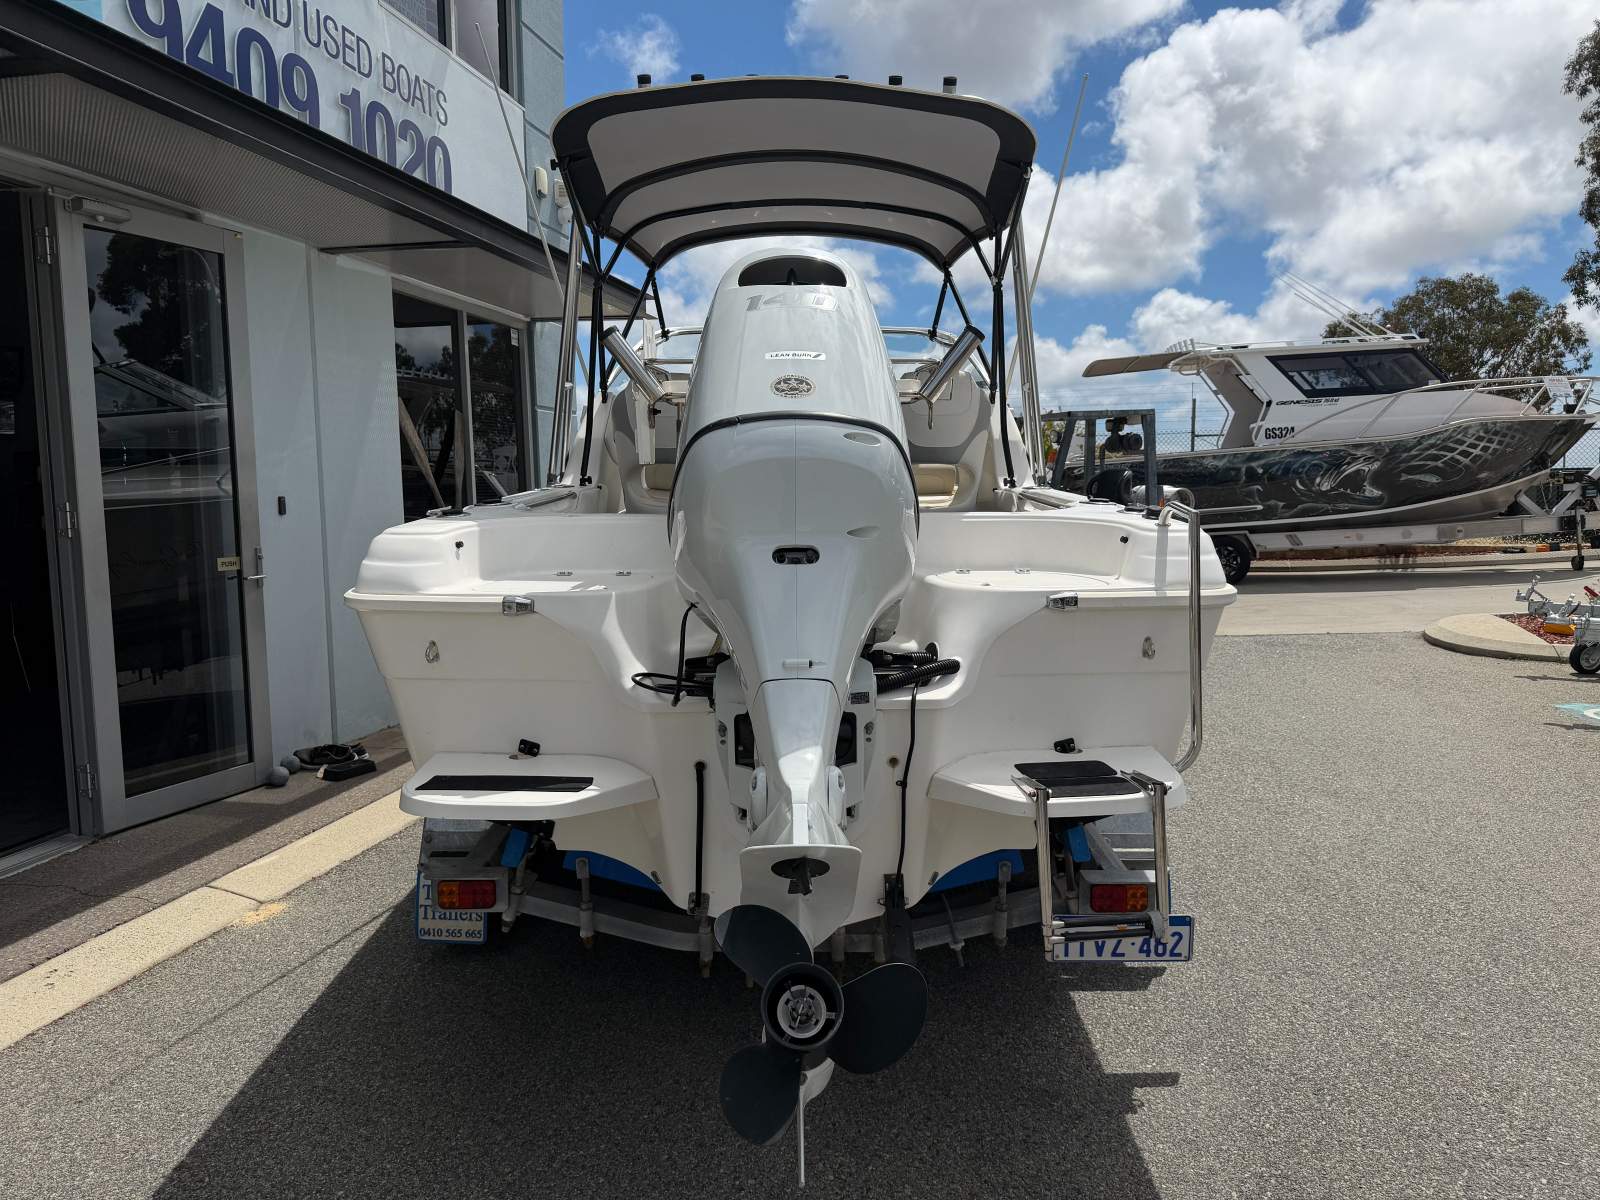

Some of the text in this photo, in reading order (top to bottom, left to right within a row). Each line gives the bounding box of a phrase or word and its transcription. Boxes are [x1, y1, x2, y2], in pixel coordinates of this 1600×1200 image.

[127, 0, 453, 195] 9409 1020
[303, 0, 448, 126] USED BOATS
[420, 928, 483, 939] 0410 565 665
